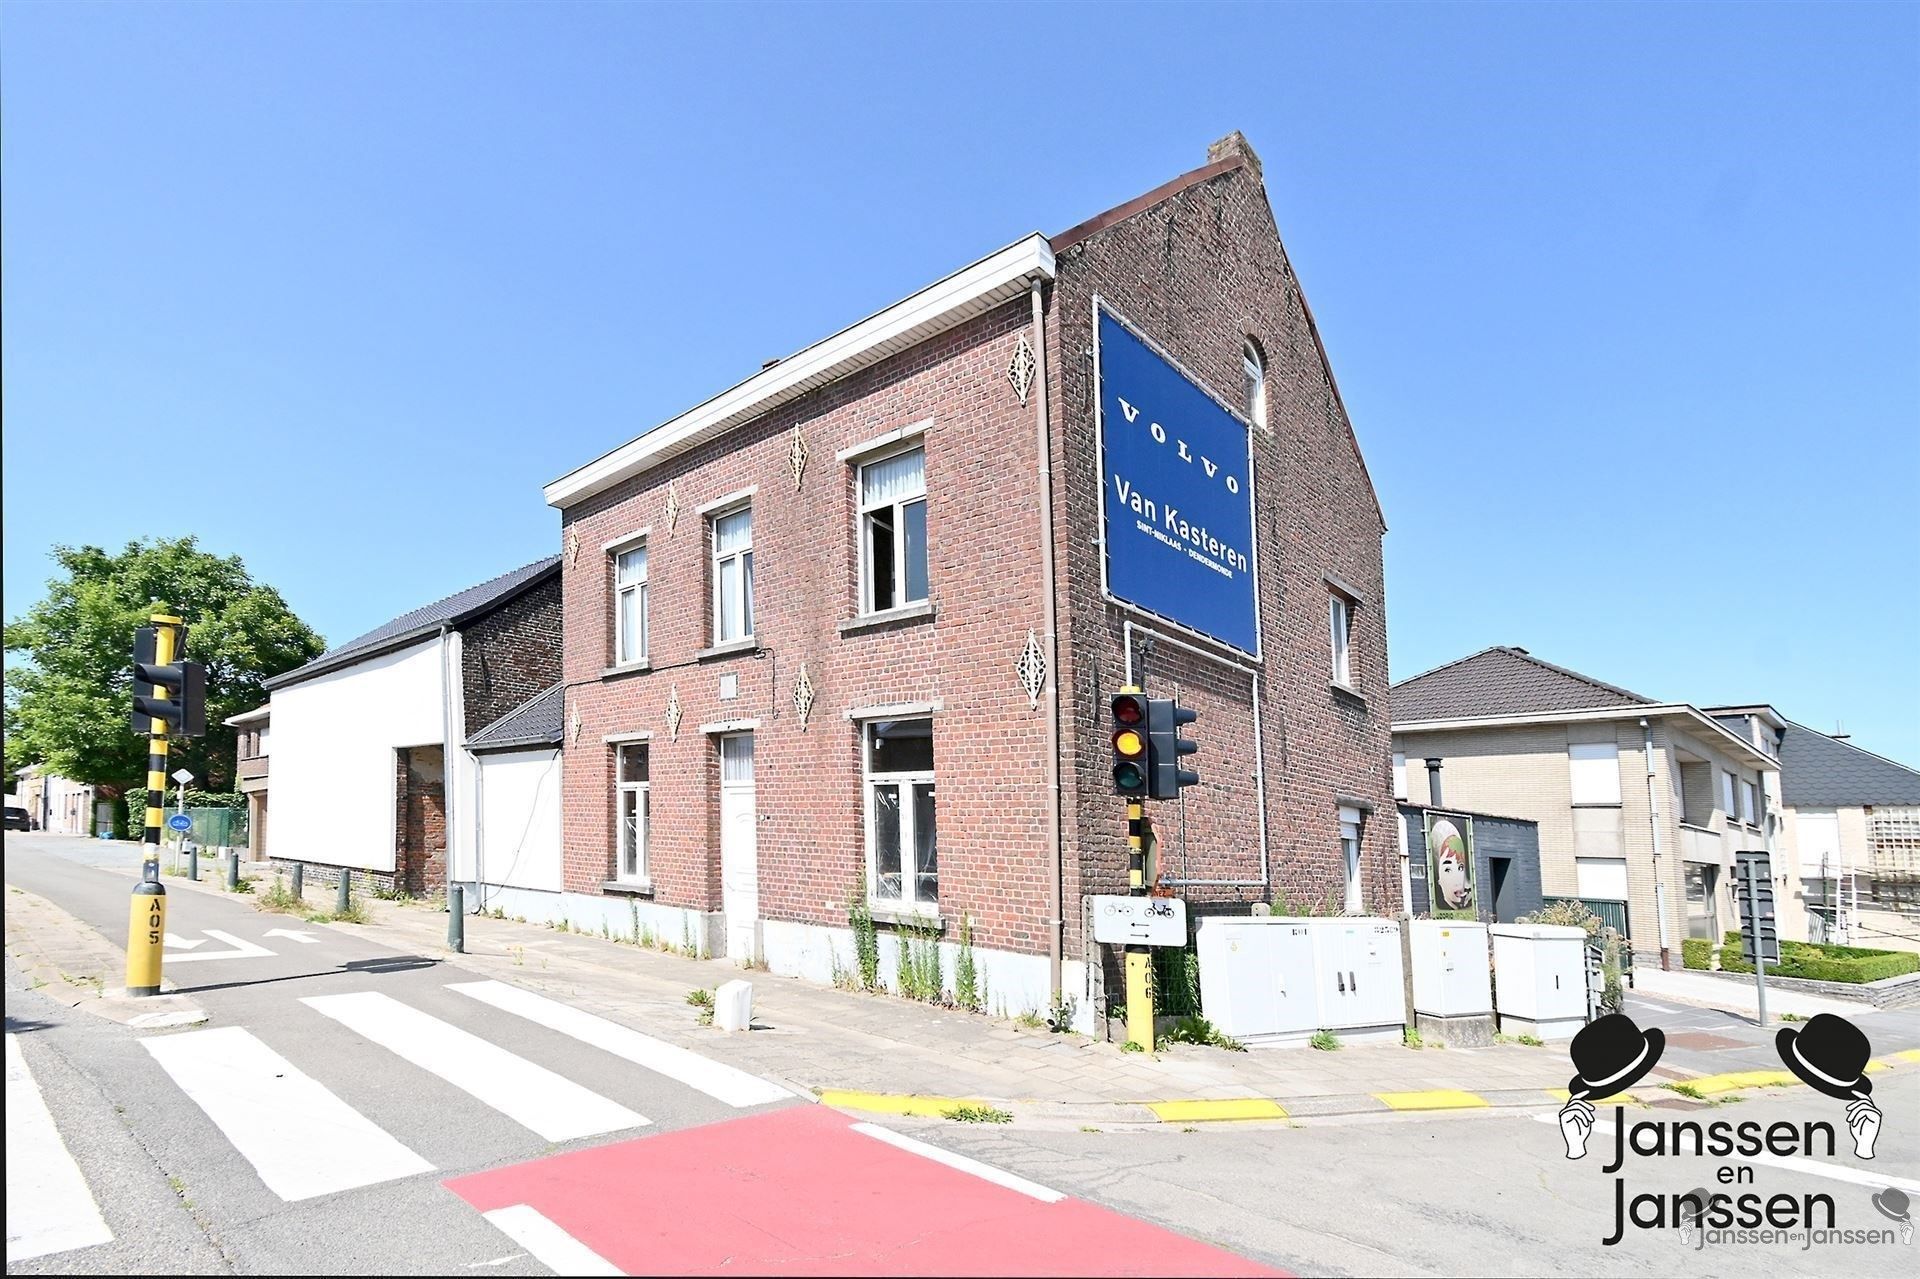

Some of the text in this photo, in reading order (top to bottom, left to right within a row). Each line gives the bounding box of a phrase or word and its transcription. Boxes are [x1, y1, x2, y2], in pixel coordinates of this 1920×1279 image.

[1118, 397, 1239, 494] VOLVO
[1114, 474, 1247, 573] Van Kasteren
[1136, 520, 1182, 552] SINT-NIKLAAS
[1188, 551, 1233, 579] DENDERMONDE
